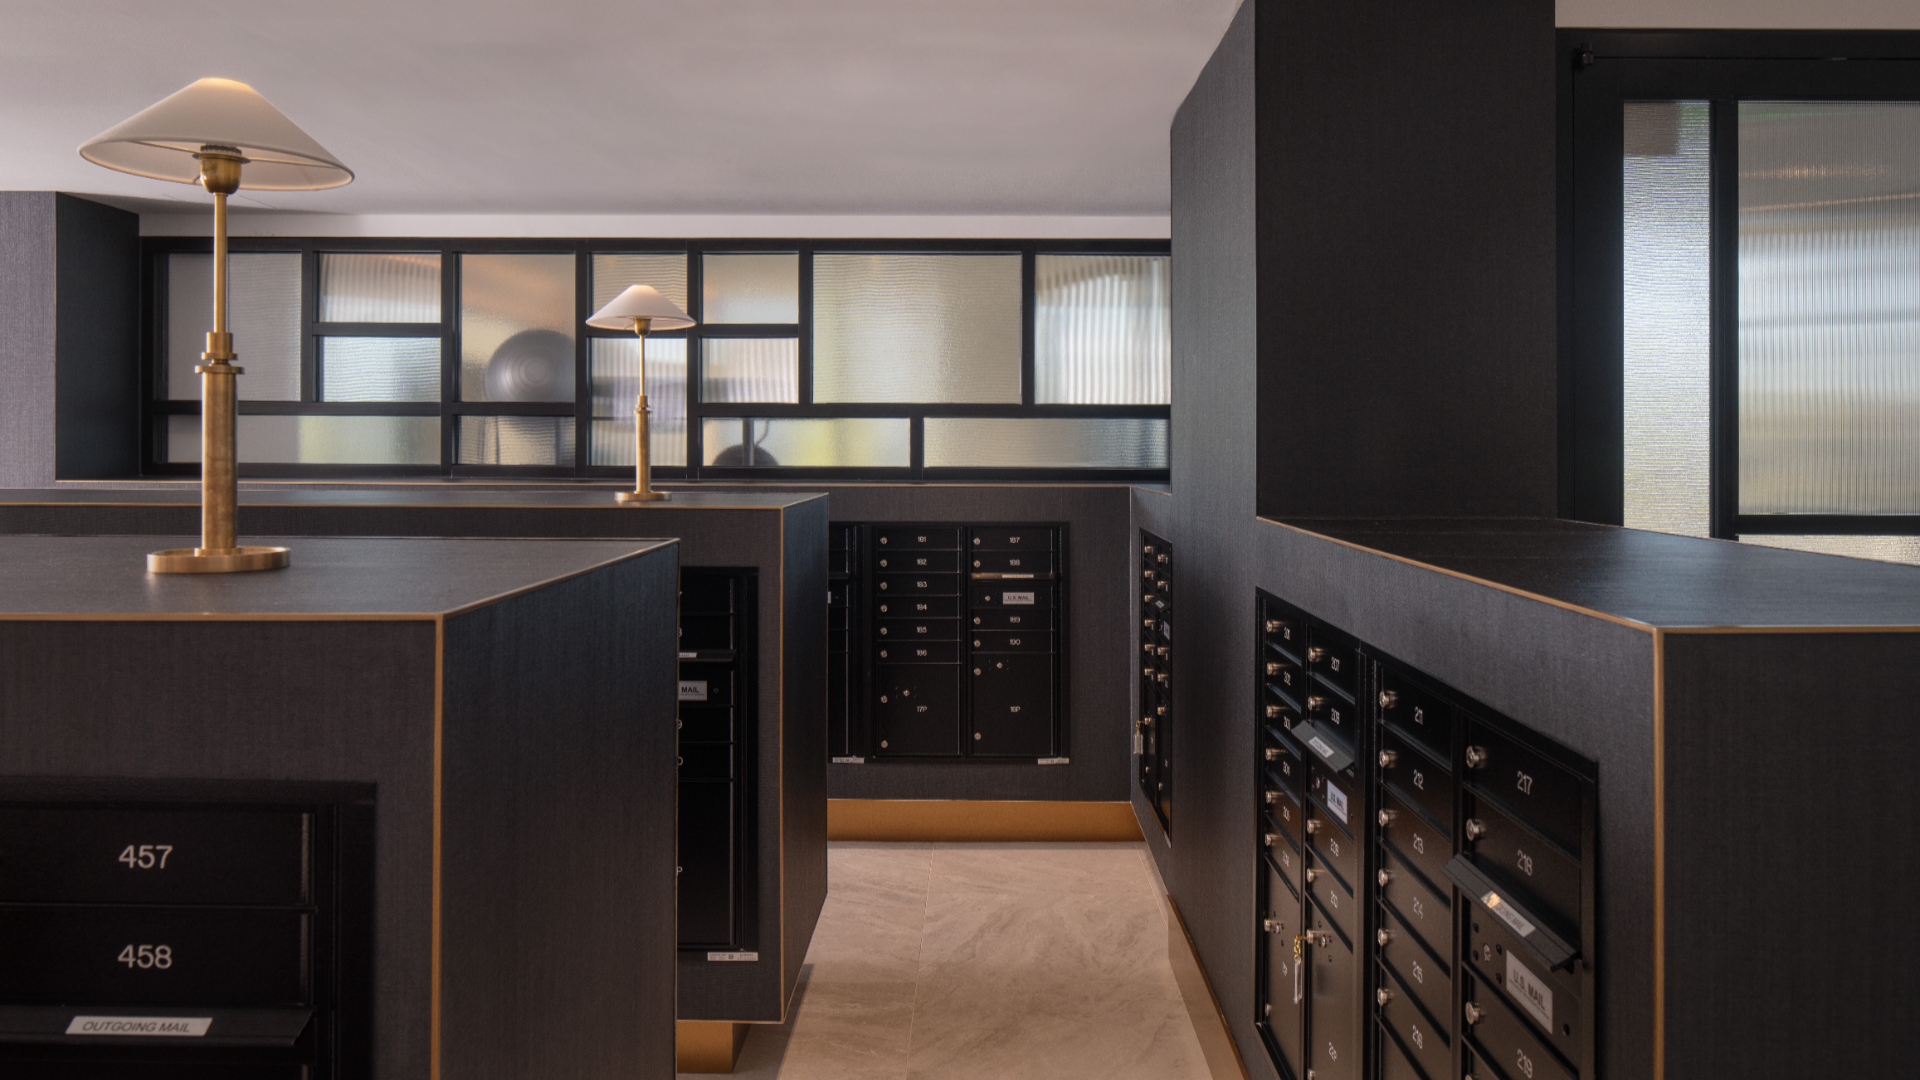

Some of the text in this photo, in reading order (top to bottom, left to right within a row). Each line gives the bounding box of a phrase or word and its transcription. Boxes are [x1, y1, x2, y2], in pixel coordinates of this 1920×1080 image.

[1331, 656, 1341, 673] 207
[681, 686, 700, 694] MAIL
[1414, 706, 1424, 726] 211
[1413, 769, 1424, 791] 212
[1516, 770, 1533, 795] 217
[1413, 833, 1424, 855] 213
[118, 844, 174, 869] 457
[1516, 849, 1533, 876] 218
[1413, 896, 1424, 919] 214
[117, 944, 173, 969] 458
[1412, 960, 1423, 984] 215
[1512, 969, 1526, 993] U.S.
[1527, 983, 1546, 1011] MAIL
[82, 1021, 190, 1033] OUTGOING MAIL
[1412, 1024, 1423, 1050] 216
[1516, 1047, 1533, 1079] 219
